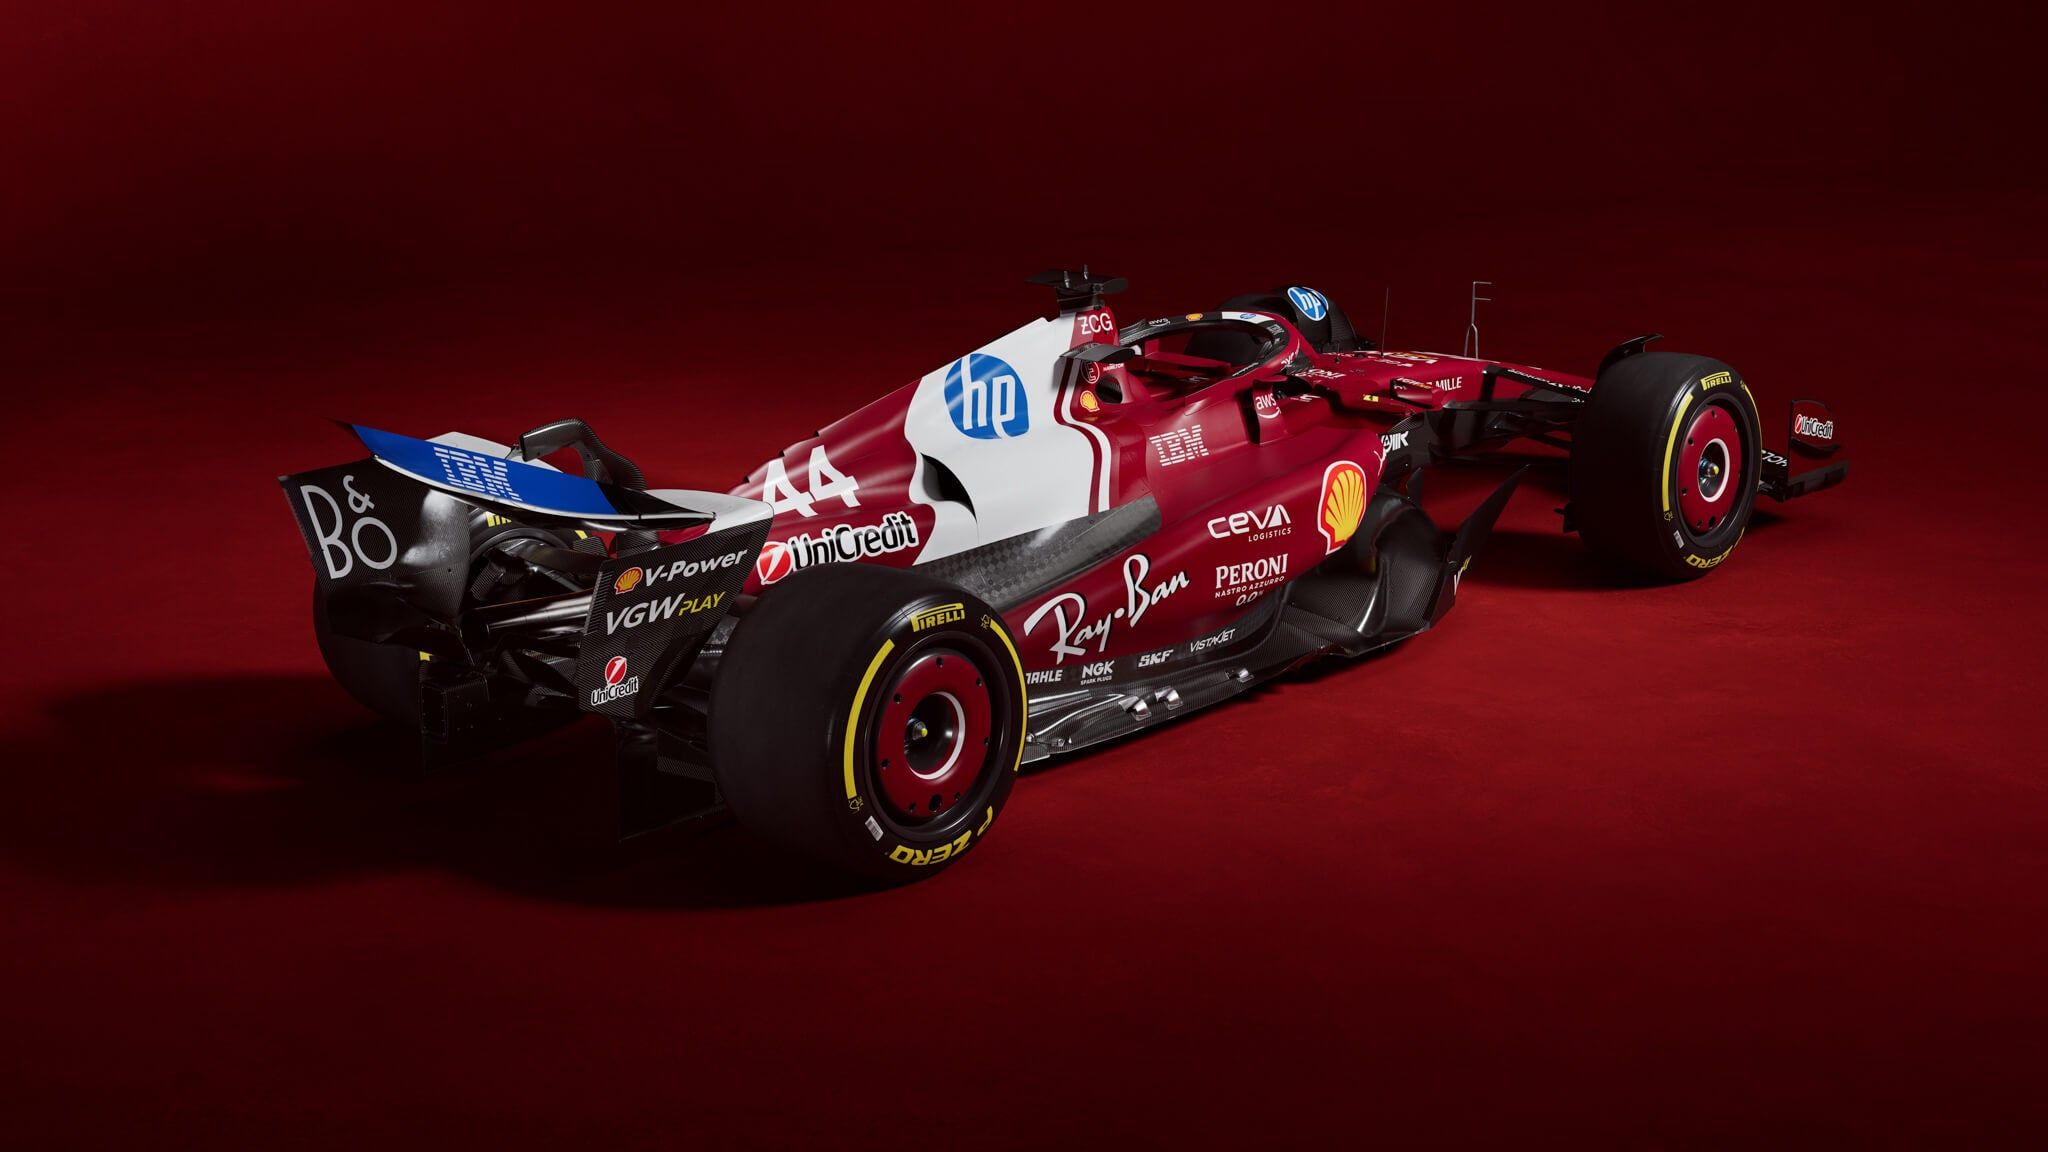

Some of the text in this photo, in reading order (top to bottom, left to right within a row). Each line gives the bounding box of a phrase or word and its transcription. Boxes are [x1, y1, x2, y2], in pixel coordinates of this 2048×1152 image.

[1078, 313, 1113, 335] ZCG
[1435, 376, 1463, 391] MILLE
[1700, 371, 1732, 391] PIRELLI
[957, 353, 1018, 439] hp
[1256, 393, 1277, 410] aws
[1801, 416, 1834, 439] UniCredit
[1149, 425, 1208, 466] IBM
[434, 447, 522, 501] IBM
[762, 445, 861, 517] 44
[790, 512, 918, 571] UniCredit
[1248, 528, 1292, 543] LOGISTICS
[646, 550, 747, 587] V-Power
[1216, 553, 1288, 589] PERONI
[1215, 575, 1285, 598] NASTRO AZZURRO
[606, 591, 725, 635] VGW PLAY
[911, 603, 965, 632] PIRELLI
[1082, 660, 1115, 678] NGK
[1138, 650, 1174, 667] SKF
[591, 676, 639, 706] UniCredit
[889, 830, 972, 865] ZERO
